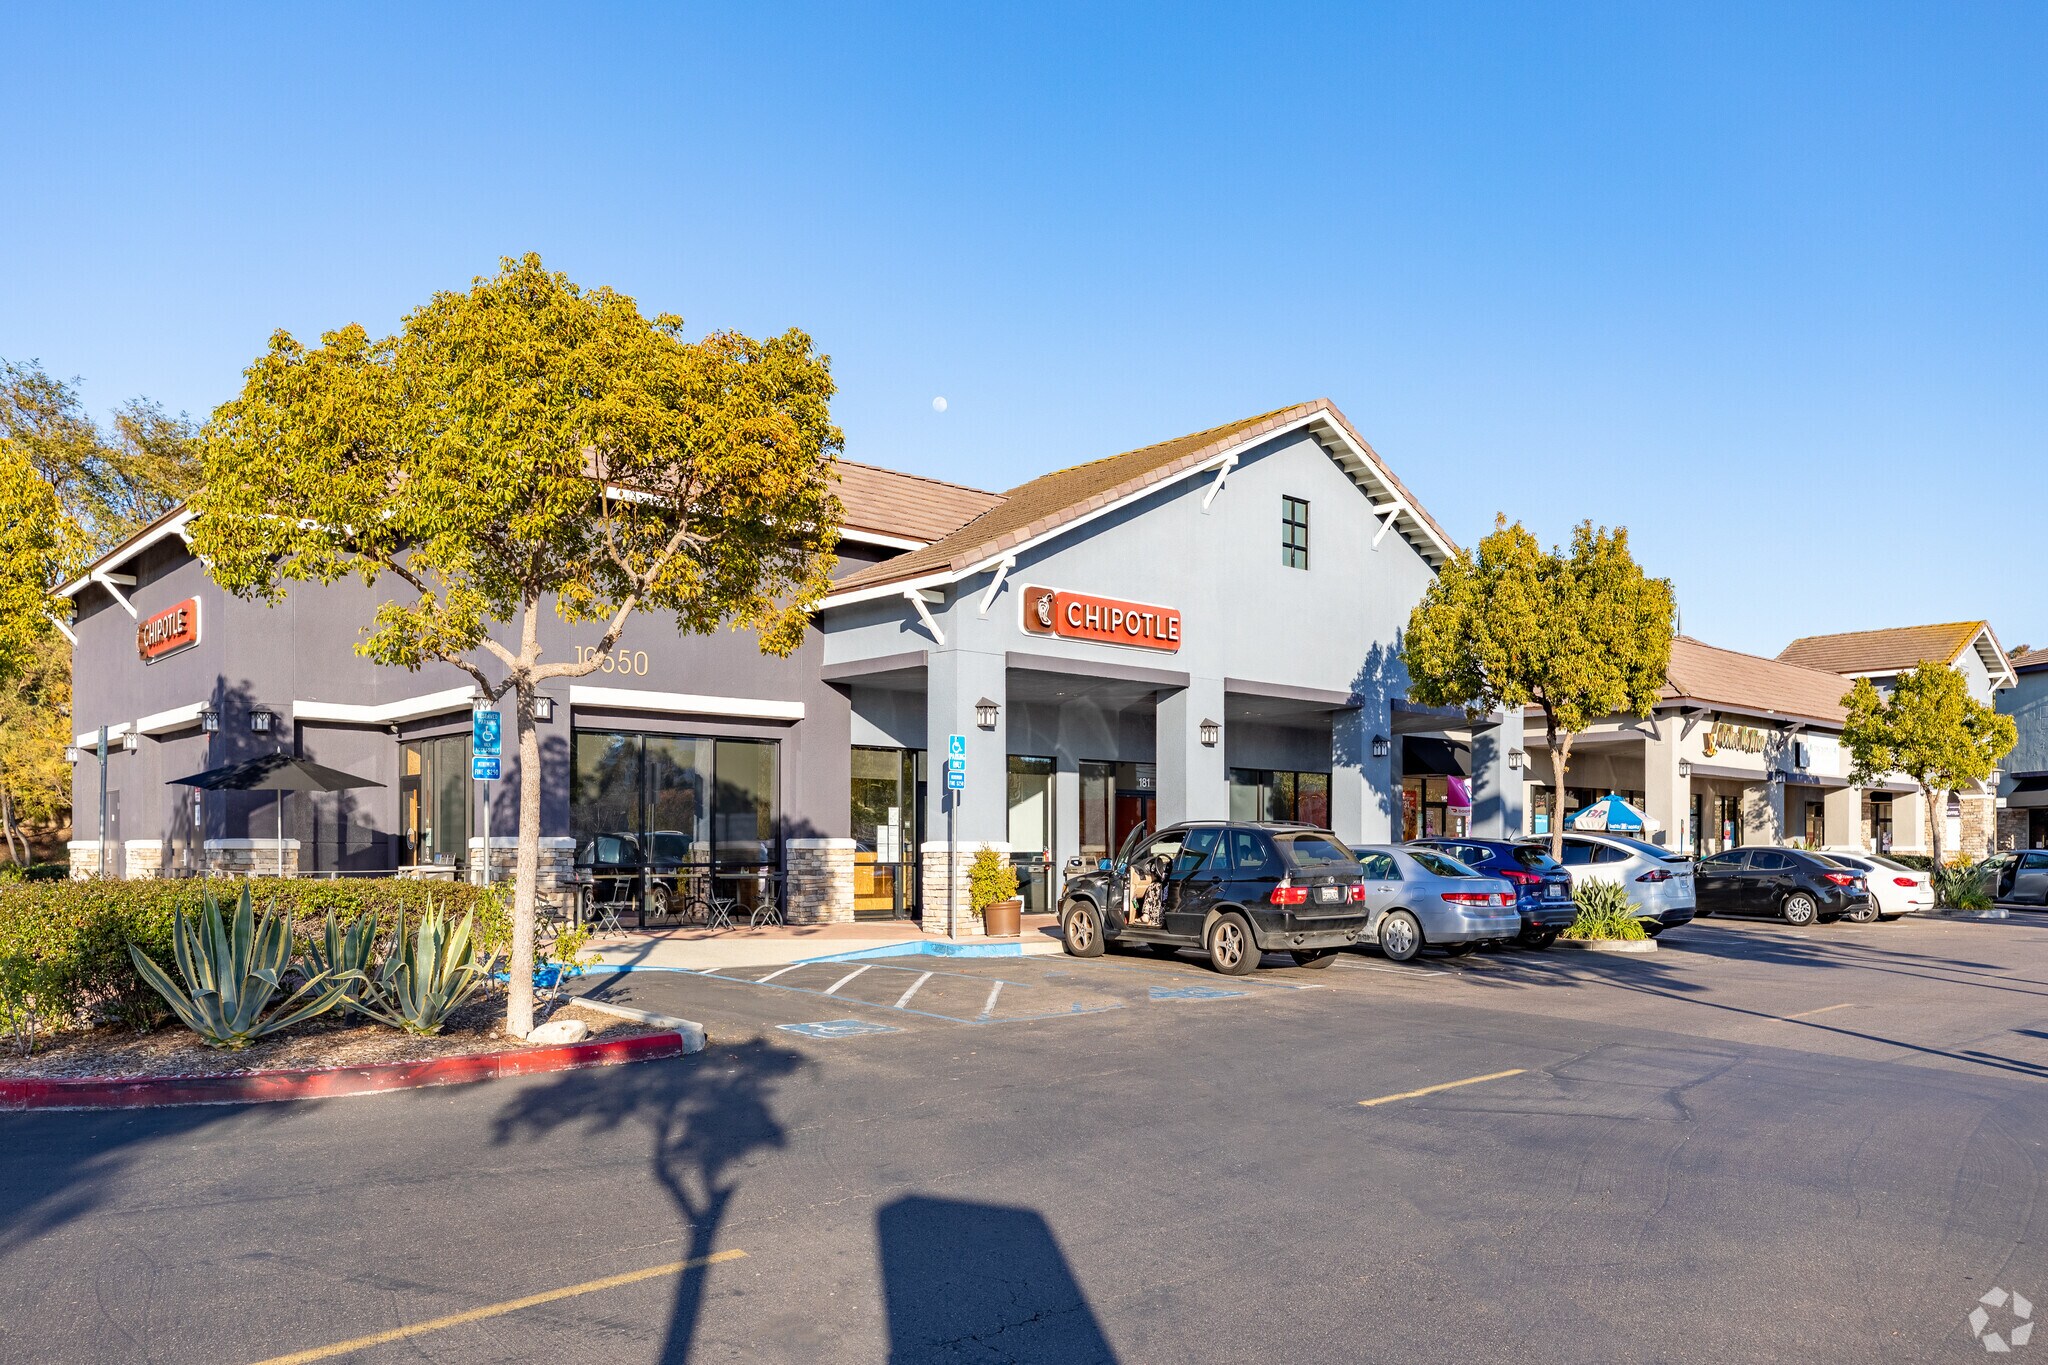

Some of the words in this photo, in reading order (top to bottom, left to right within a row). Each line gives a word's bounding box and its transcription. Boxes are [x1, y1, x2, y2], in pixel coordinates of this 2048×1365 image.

[144, 608, 183, 646] CHIPOTLE
[1067, 602, 1180, 641] CHIPOTLE
[1139, 778, 1150, 787] 181
[1586, 809, 1607, 818] BR
